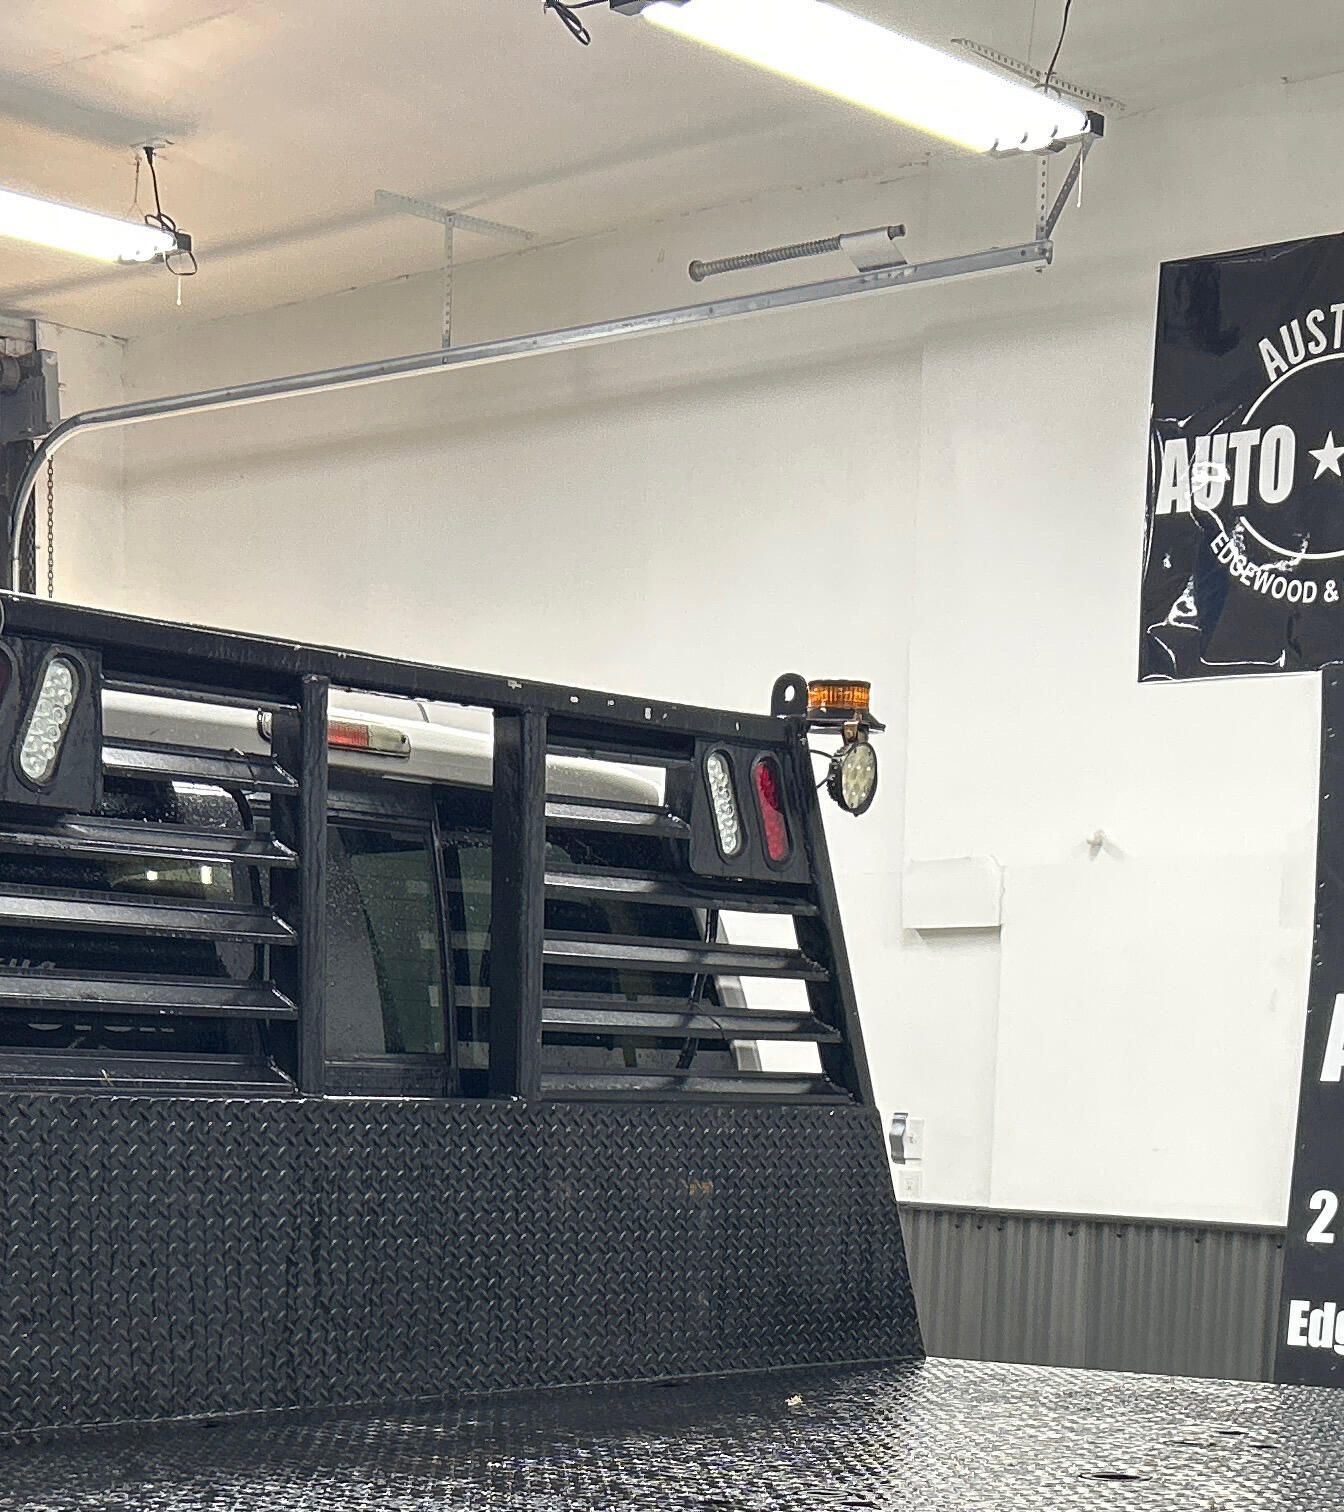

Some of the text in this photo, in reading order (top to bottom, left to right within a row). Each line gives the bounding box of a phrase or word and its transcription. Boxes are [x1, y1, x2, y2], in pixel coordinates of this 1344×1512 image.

[1155, 424, 1296, 515] AUTO
[1210, 531, 1318, 604] EDGEWOOD
[1323, 579, 1340, 603] &
